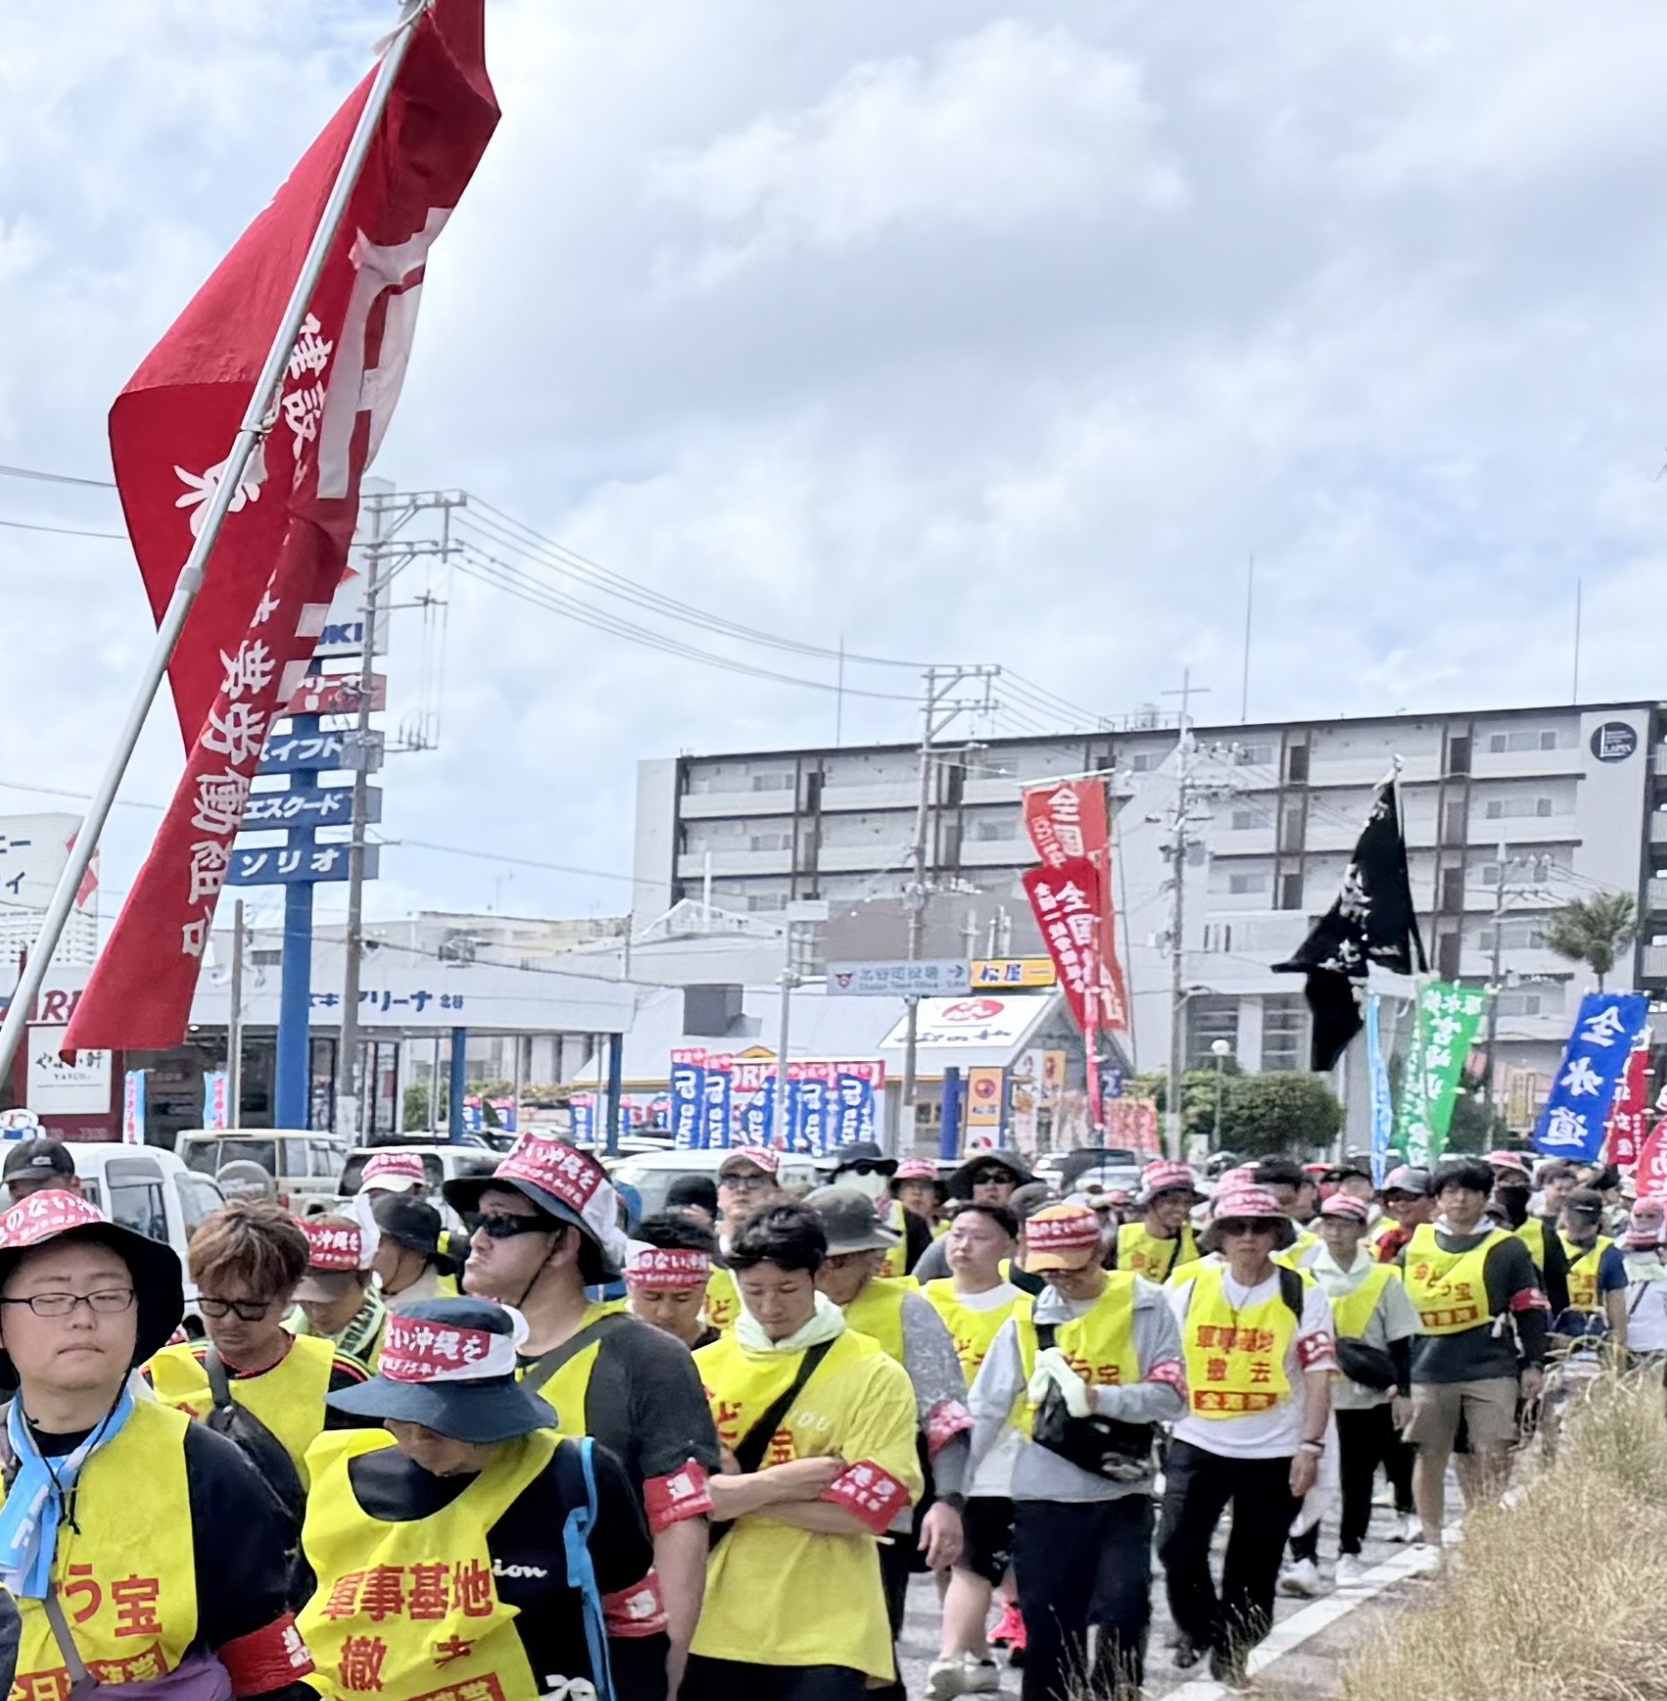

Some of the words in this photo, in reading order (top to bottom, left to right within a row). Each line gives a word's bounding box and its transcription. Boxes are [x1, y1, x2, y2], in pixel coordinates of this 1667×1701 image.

[243, 793, 344, 820] エスクード
[240, 848, 340, 877] ソリオ
[1539, 1005, 1625, 1147] 全水道
